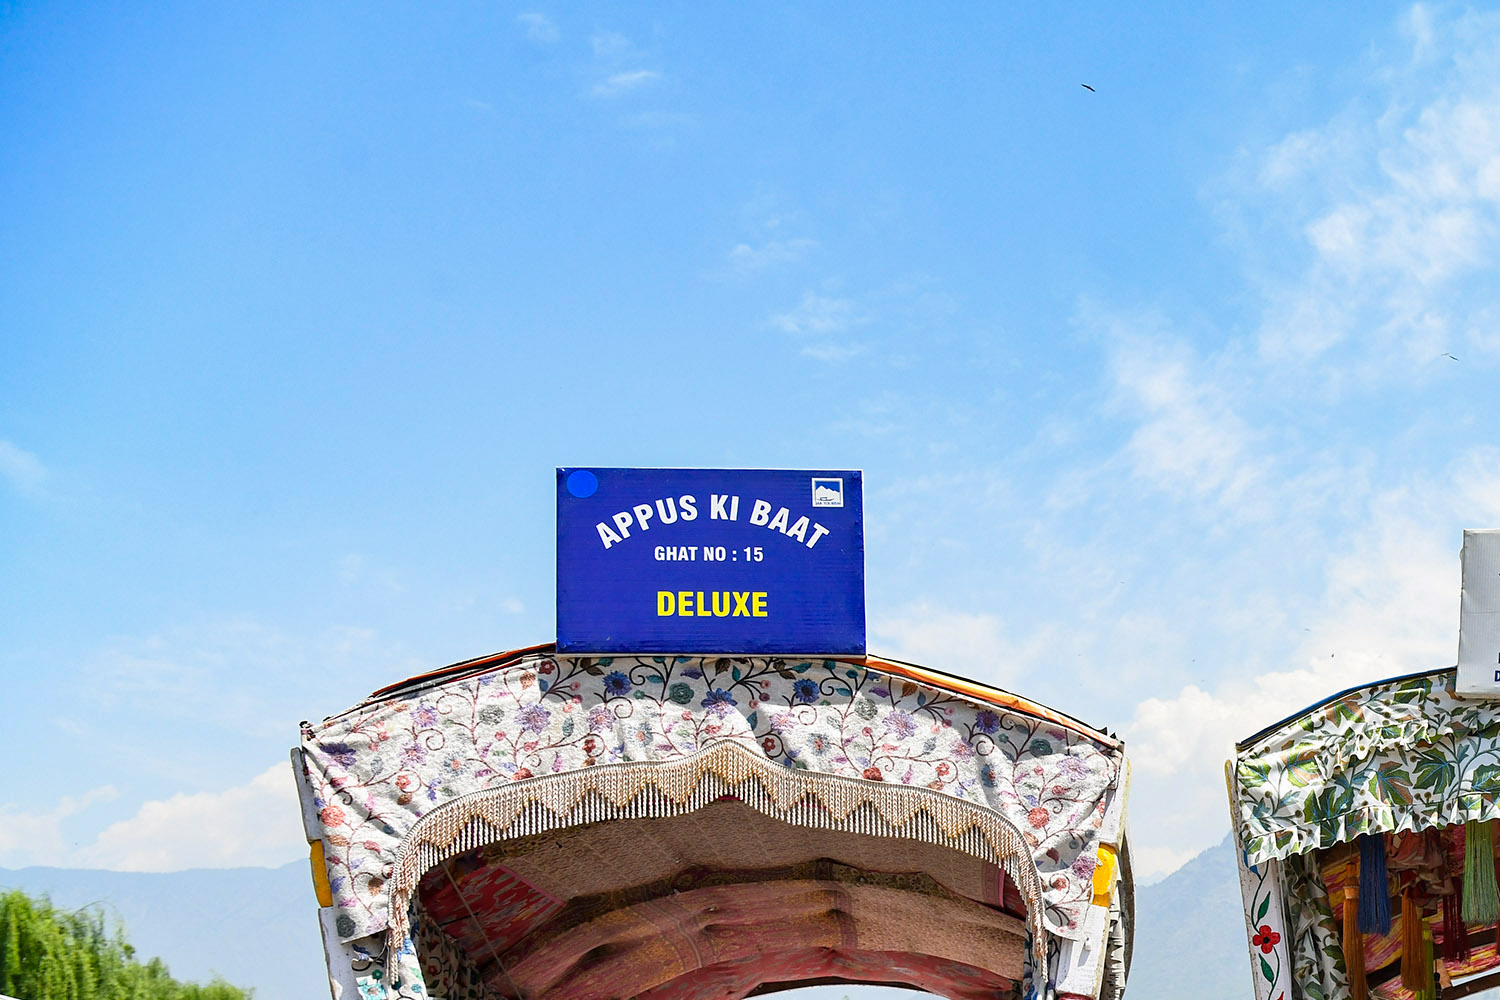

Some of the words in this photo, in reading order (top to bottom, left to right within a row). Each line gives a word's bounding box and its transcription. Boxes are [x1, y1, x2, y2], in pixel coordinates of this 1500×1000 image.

[596, 494, 698, 549] APPUS
[710, 494, 739, 521] KI
[750, 499, 830, 549] BAAT
[654, 546, 698, 561] GHAT
[703, 547, 726, 562] NO
[744, 547, 764, 562] 15
[657, 591, 768, 617] DELUXE
